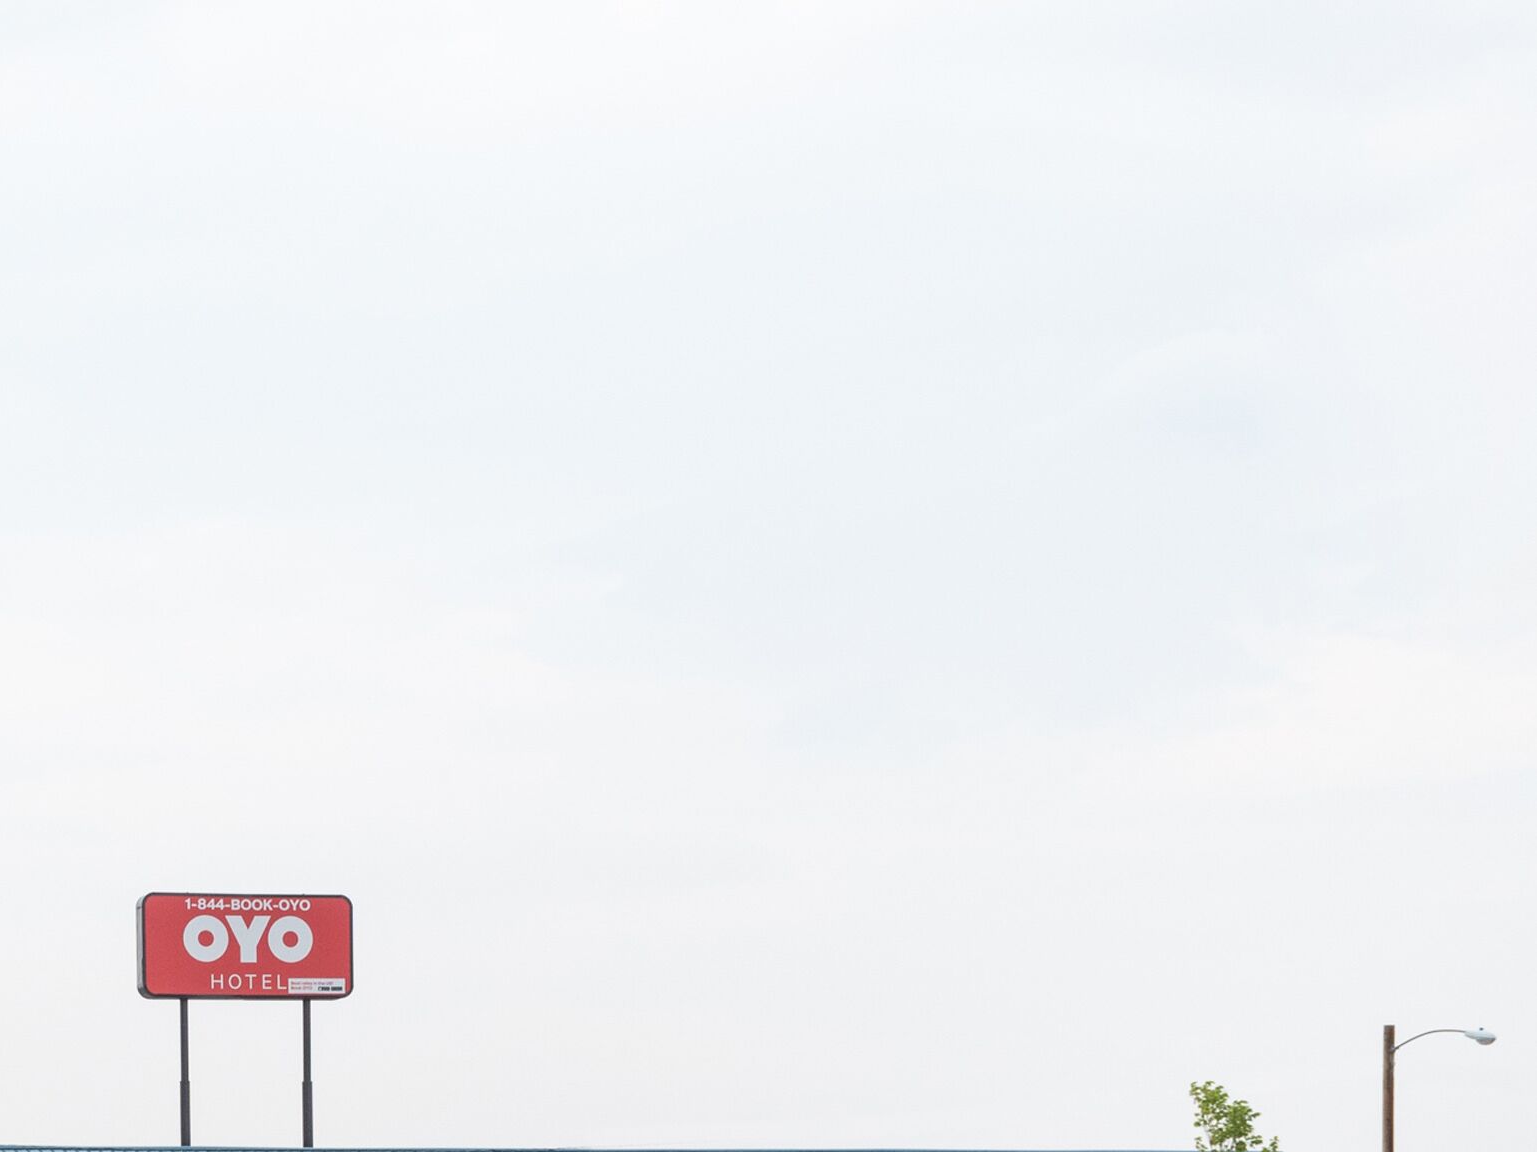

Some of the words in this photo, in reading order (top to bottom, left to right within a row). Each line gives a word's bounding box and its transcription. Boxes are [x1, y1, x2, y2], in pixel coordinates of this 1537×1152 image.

[185, 898, 311, 911] 1-844-BOOK-OYO
[183, 915, 313, 963] OYO
[210, 973, 287, 990] HOTEL
